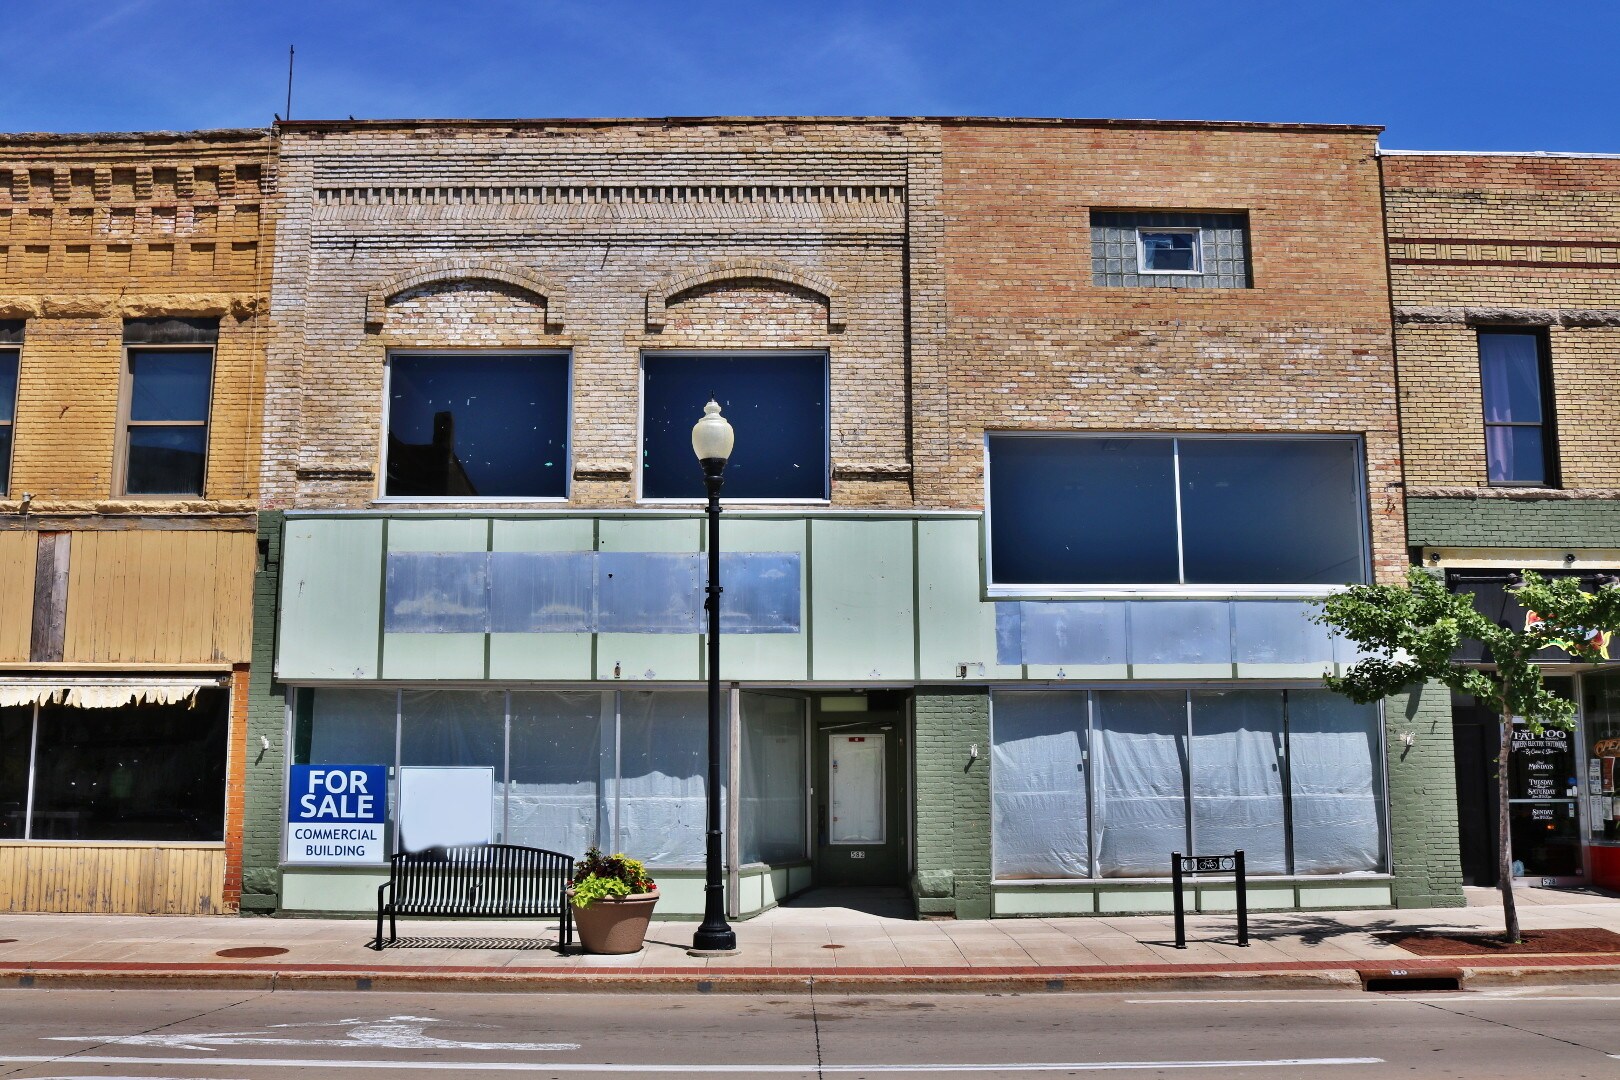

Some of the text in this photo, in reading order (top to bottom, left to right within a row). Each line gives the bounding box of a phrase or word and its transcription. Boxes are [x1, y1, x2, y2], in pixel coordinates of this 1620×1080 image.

[309, 770, 368, 794] FOR
[1527, 788, 1556, 796] SATURDAY
[300, 794, 374, 819] SALE
[295, 828, 377, 840] COMMERCIAL
[306, 845, 365, 856] BUILDING
